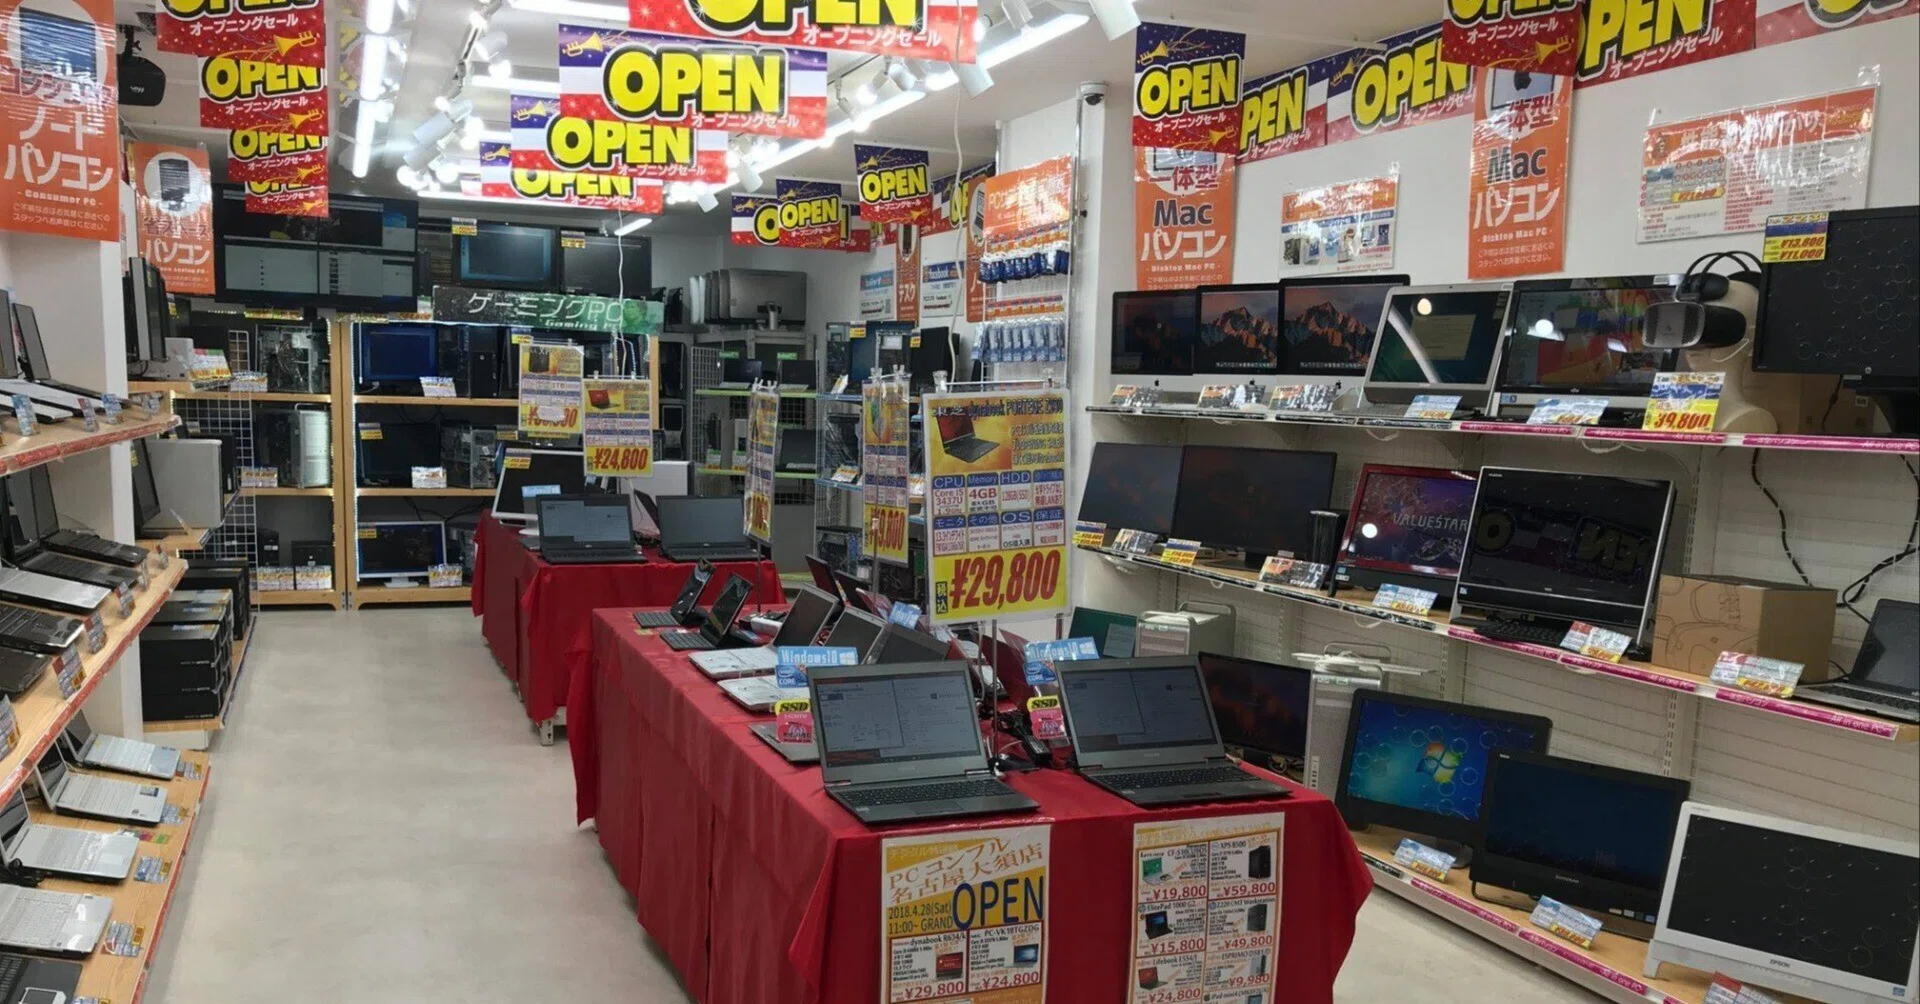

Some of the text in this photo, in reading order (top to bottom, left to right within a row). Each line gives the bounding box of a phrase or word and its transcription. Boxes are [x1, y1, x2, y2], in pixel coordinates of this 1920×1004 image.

[190, 14, 299, 36] オープニングセール
[1467, 18, 1558, 43] オープニングセール
[803, 26, 943, 47] オープニングセール
[1610, 27, 1724, 78] オープニングセール
[205, 56, 318, 99] OPEN
[608, 49, 781, 114] OPEN
[1140, 59, 1237, 116] OPEN
[1355, 36, 1467, 127] OPEN
[225, 97, 308, 115] オープニングセール
[1240, 75, 1305, 151] PEN
[1404, 91, 1476, 125] オープニングセー
[20, 106, 104, 151] ノート
[692, 111, 800, 128] オープニングセール
[1155, 112, 1227, 132] オープニングセール
[550, 116, 691, 165] OPEN
[1251, 131, 1312, 159] オープニングセール
[4, 142, 114, 192] パソコン
[248, 154, 313, 170] オープニングセール
[618, 163, 707, 180] オープニングセール
[1487, 148, 1547, 185] Mac
[861, 167, 928, 203] OPEN
[1148, 165, 1218, 192] 一体型
[25, 189, 97, 206] Consumer PC
[873, 199, 921, 213] オープニングセール
[1473, 183, 1560, 230] パソコン
[781, 197, 839, 230] OPEN
[1153, 199, 1213, 228] Mac
[145, 239, 210, 265] パソコン
[1141, 229, 1227, 262] パソコン
[468, 292, 624, 323] ゲーミングPC
[545, 319, 598, 331] Gaming
[592, 447, 649, 470] ¥24,800
[934, 477, 964, 488] CPU
[1000, 472, 1031, 484] HDD
[968, 488, 997, 499] 4GB
[935, 518, 964, 528] モニタ
[969, 514, 998, 524] その他
[1002, 511, 1031, 523] OS
[1035, 509, 1062, 520] 保証
[1392, 512, 1469, 533] VALUESTAR
[949, 549, 1061, 610] ¥29,800
[780, 649, 838, 664] Windows10
[778, 677, 796, 685] CORE
[779, 701, 809, 712] SSD
[1031, 698, 1058, 709] SSD
[1830, 713, 1844, 724] All
[1852, 721, 1870, 731] one
[889, 868, 919, 890] PC
[925, 838, 1012, 876] コンフル
[891, 842, 1044, 904] 名古屋大須店
[1152, 884, 1207, 901] ¥19,800
[1223, 881, 1276, 897] ¥59,800
[888, 902, 951, 919] 2018.4.28(Sat)
[952, 875, 1044, 930] OPEN
[920, 915, 953, 931] GRAND
[910, 934, 942, 947] dynabook
[1151, 937, 1204, 955] ¥15,800
[1224, 935, 1273, 950] ¥49,800
[1769, 958, 1791, 968] EPSON
[904, 980, 965, 999] ¥29,800
[982, 970, 1040, 990] ¥24,800
[1228, 973, 1270, 988] ¥9,980
[1148, 987, 1201, 1004] ¥24,800
